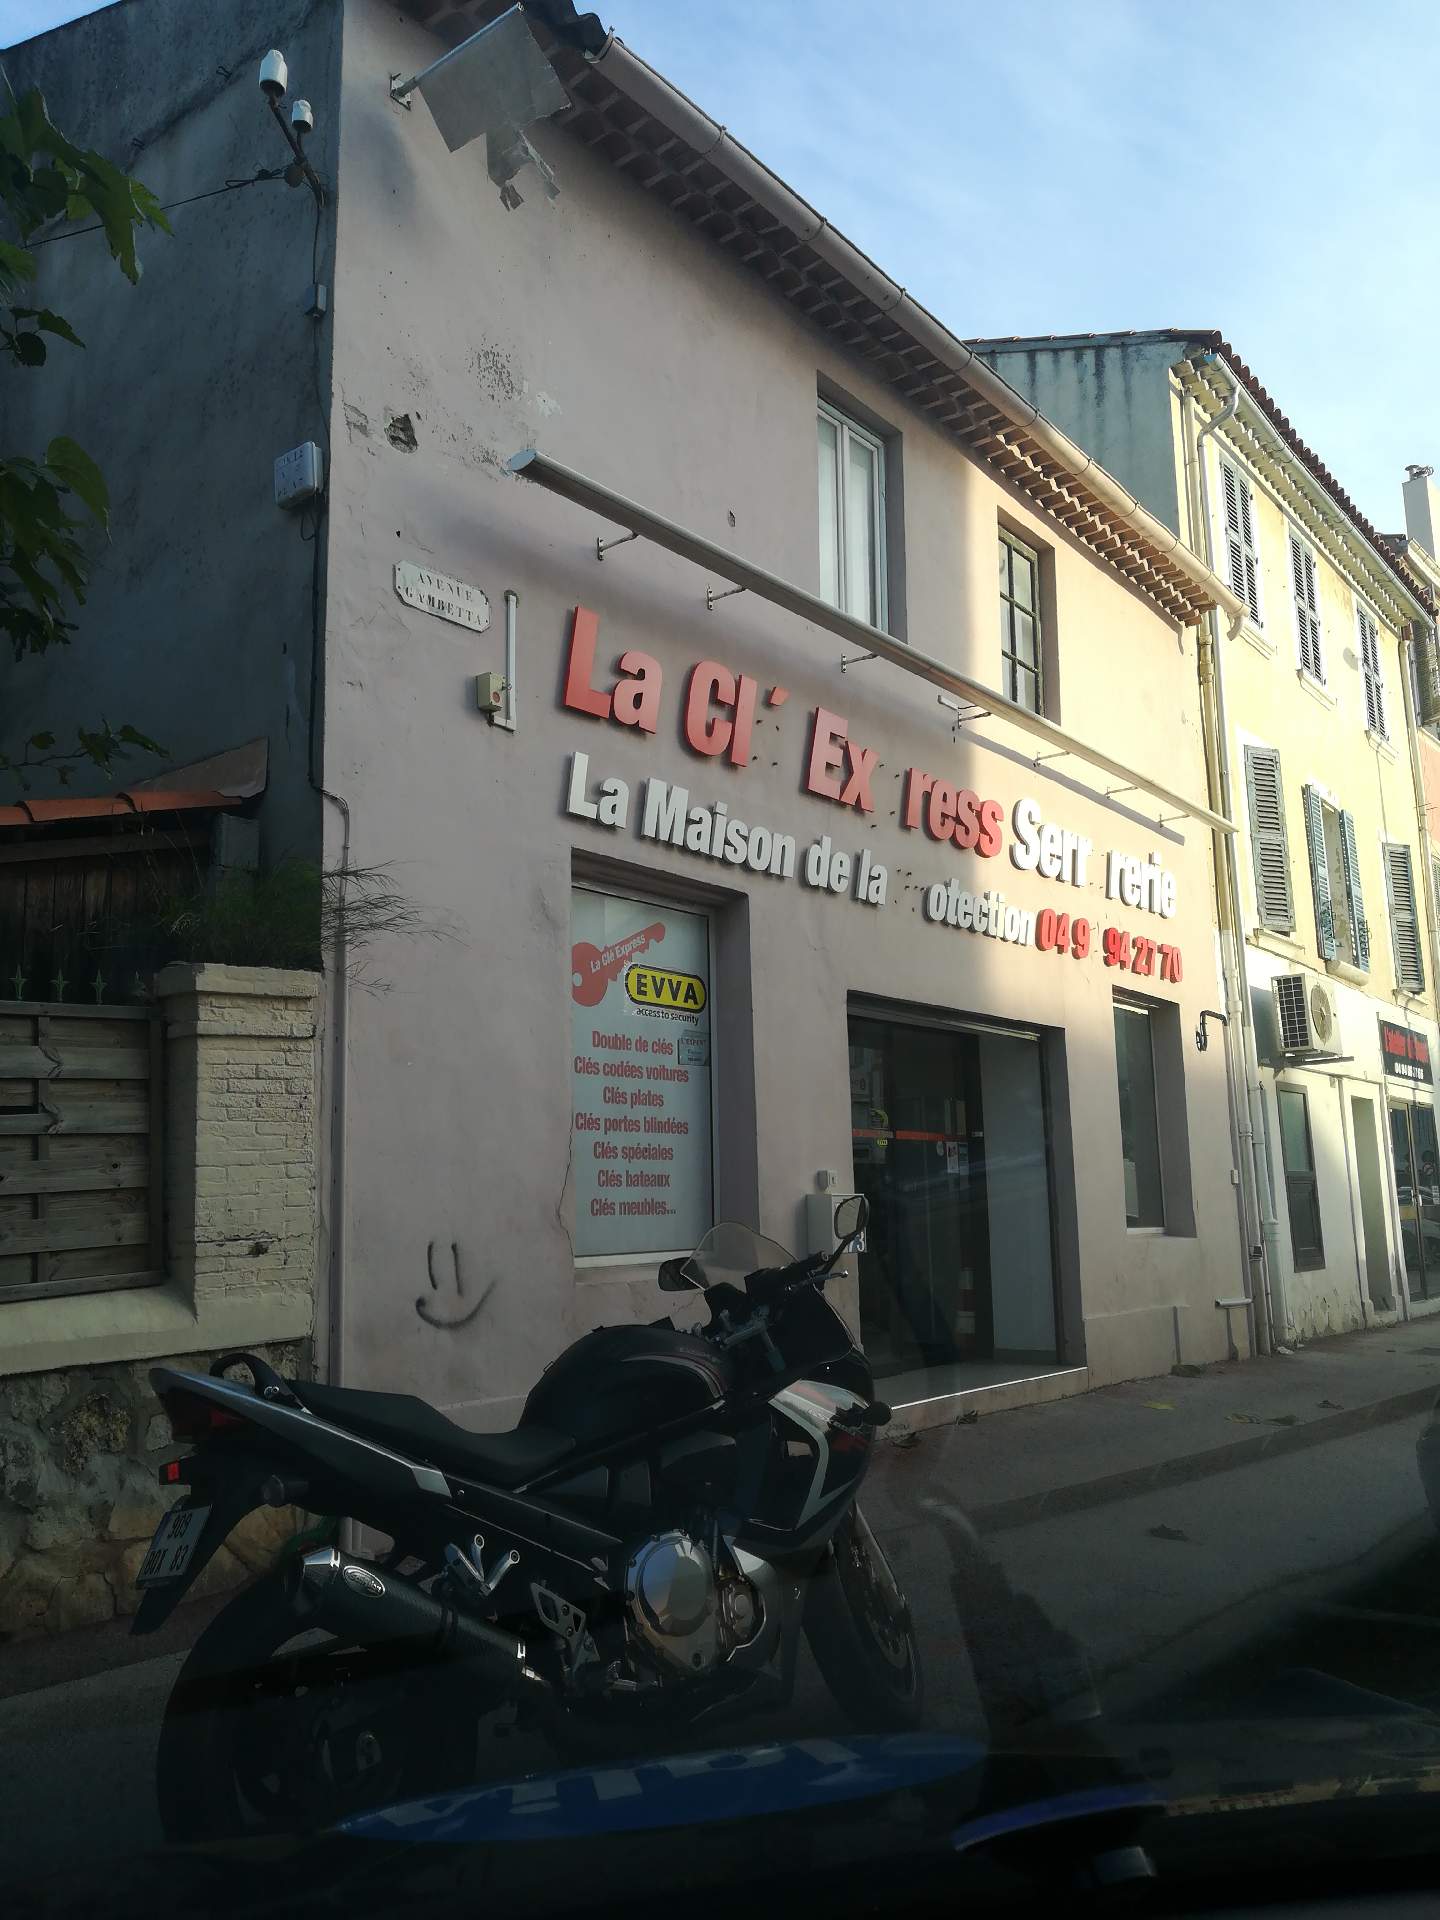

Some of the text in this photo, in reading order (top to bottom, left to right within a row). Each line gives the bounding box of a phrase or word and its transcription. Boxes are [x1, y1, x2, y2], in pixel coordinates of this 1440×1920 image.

[418, 572, 473, 602] AVENUE
[405, 586, 482, 626] GAMBETTA
[564, 606, 662, 734] La
[567, 751, 630, 829] La
[641, 777, 796, 878] Maison
[805, 834, 850, 893] de
[855, 848, 888, 905] la
[615, 934, 646, 958] Express
[636, 973, 699, 1005] EVVA
[636, 1007, 699, 1026] access to security
[592, 1030, 632, 1051] Double
[634, 1036, 649, 1053] de
[651, 1039, 674, 1056] clés
[574, 1056, 689, 1083] Clés codées voitures
[603, 1085, 664, 1109] Clés plates
[575, 1112, 689, 1135] Clés portes blindées
[593, 1141, 674, 1163] Clés spéciales
[597, 1169, 670, 1188] Clés bateaux
[591, 1198, 615, 1217] Clés
